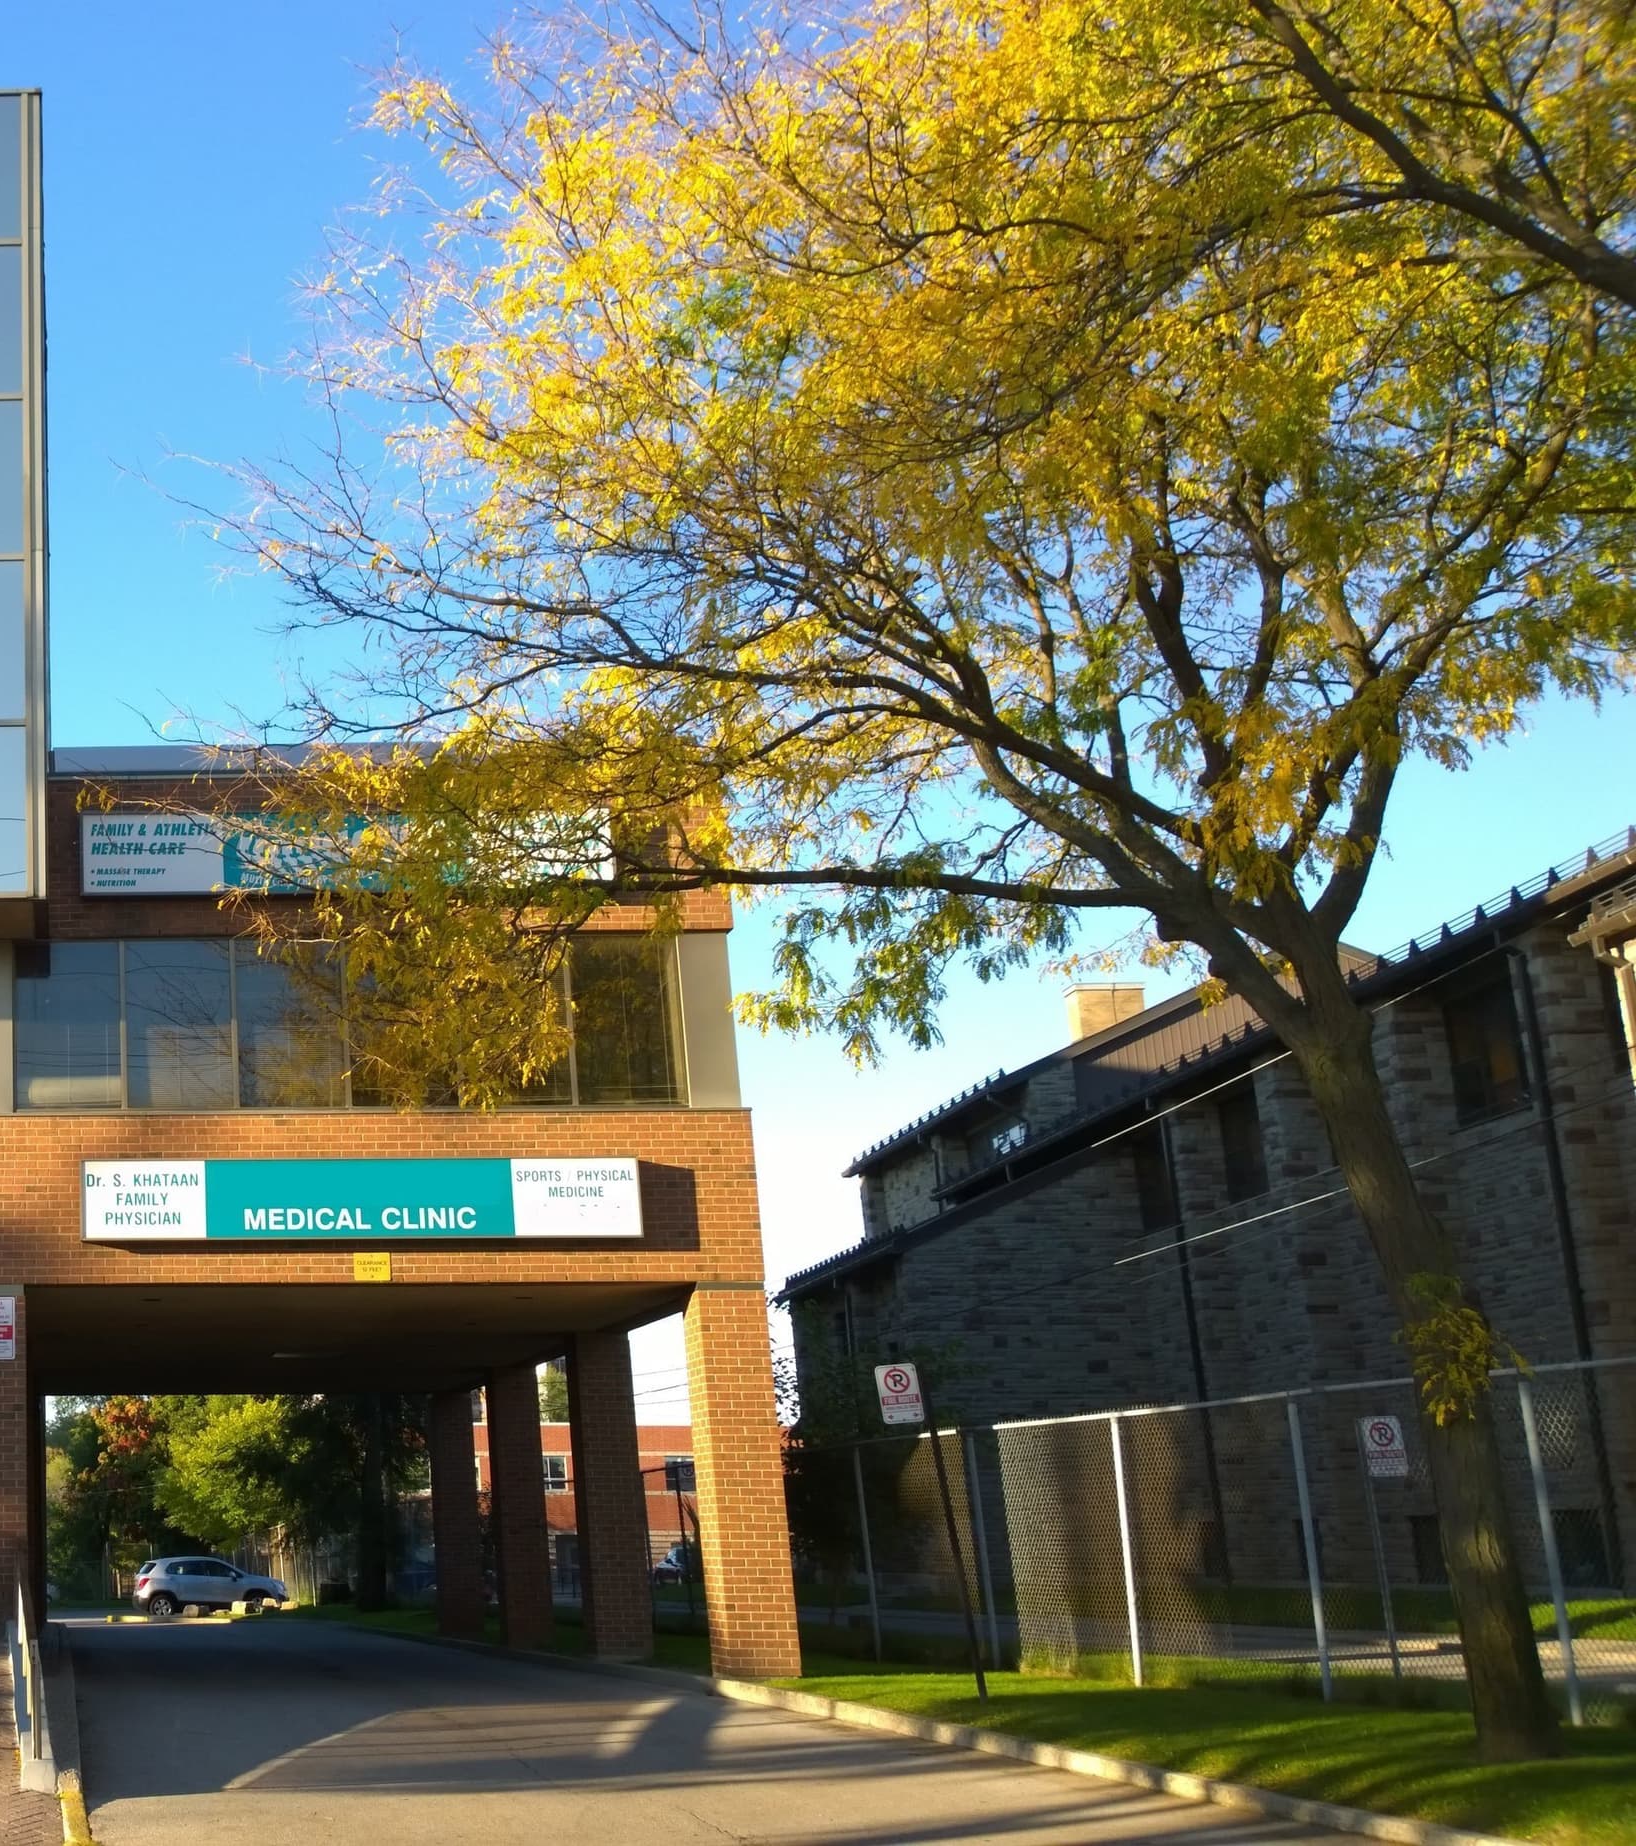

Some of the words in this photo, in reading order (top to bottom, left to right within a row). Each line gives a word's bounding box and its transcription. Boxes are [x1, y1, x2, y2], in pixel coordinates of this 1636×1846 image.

[91, 824, 134, 836] FAMILY
[138, 823, 146, 836] &
[154, 823, 216, 836] ATHLETI
[91, 842, 144, 856] HEALTH
[148, 842, 186, 855] CARE
[96, 867, 130, 876] MASSAGE
[133, 867, 166, 875] THERAPY
[96, 879, 136, 887] NUTRITION
[86, 1173, 106, 1187] Dr.
[113, 1173, 126, 1187] S.
[133, 1173, 199, 1187] KHATAAN
[516, 1170, 562, 1182] SPORTS
[577, 1169, 634, 1182] PHYSICAL
[548, 1186, 604, 1198] MEDICINE
[116, 1193, 169, 1206] FAMILY
[105, 1211, 181, 1225] PHYSICIAN
[243, 1207, 372, 1231] MEDICAL
[380, 1206, 477, 1230] CLINIC
